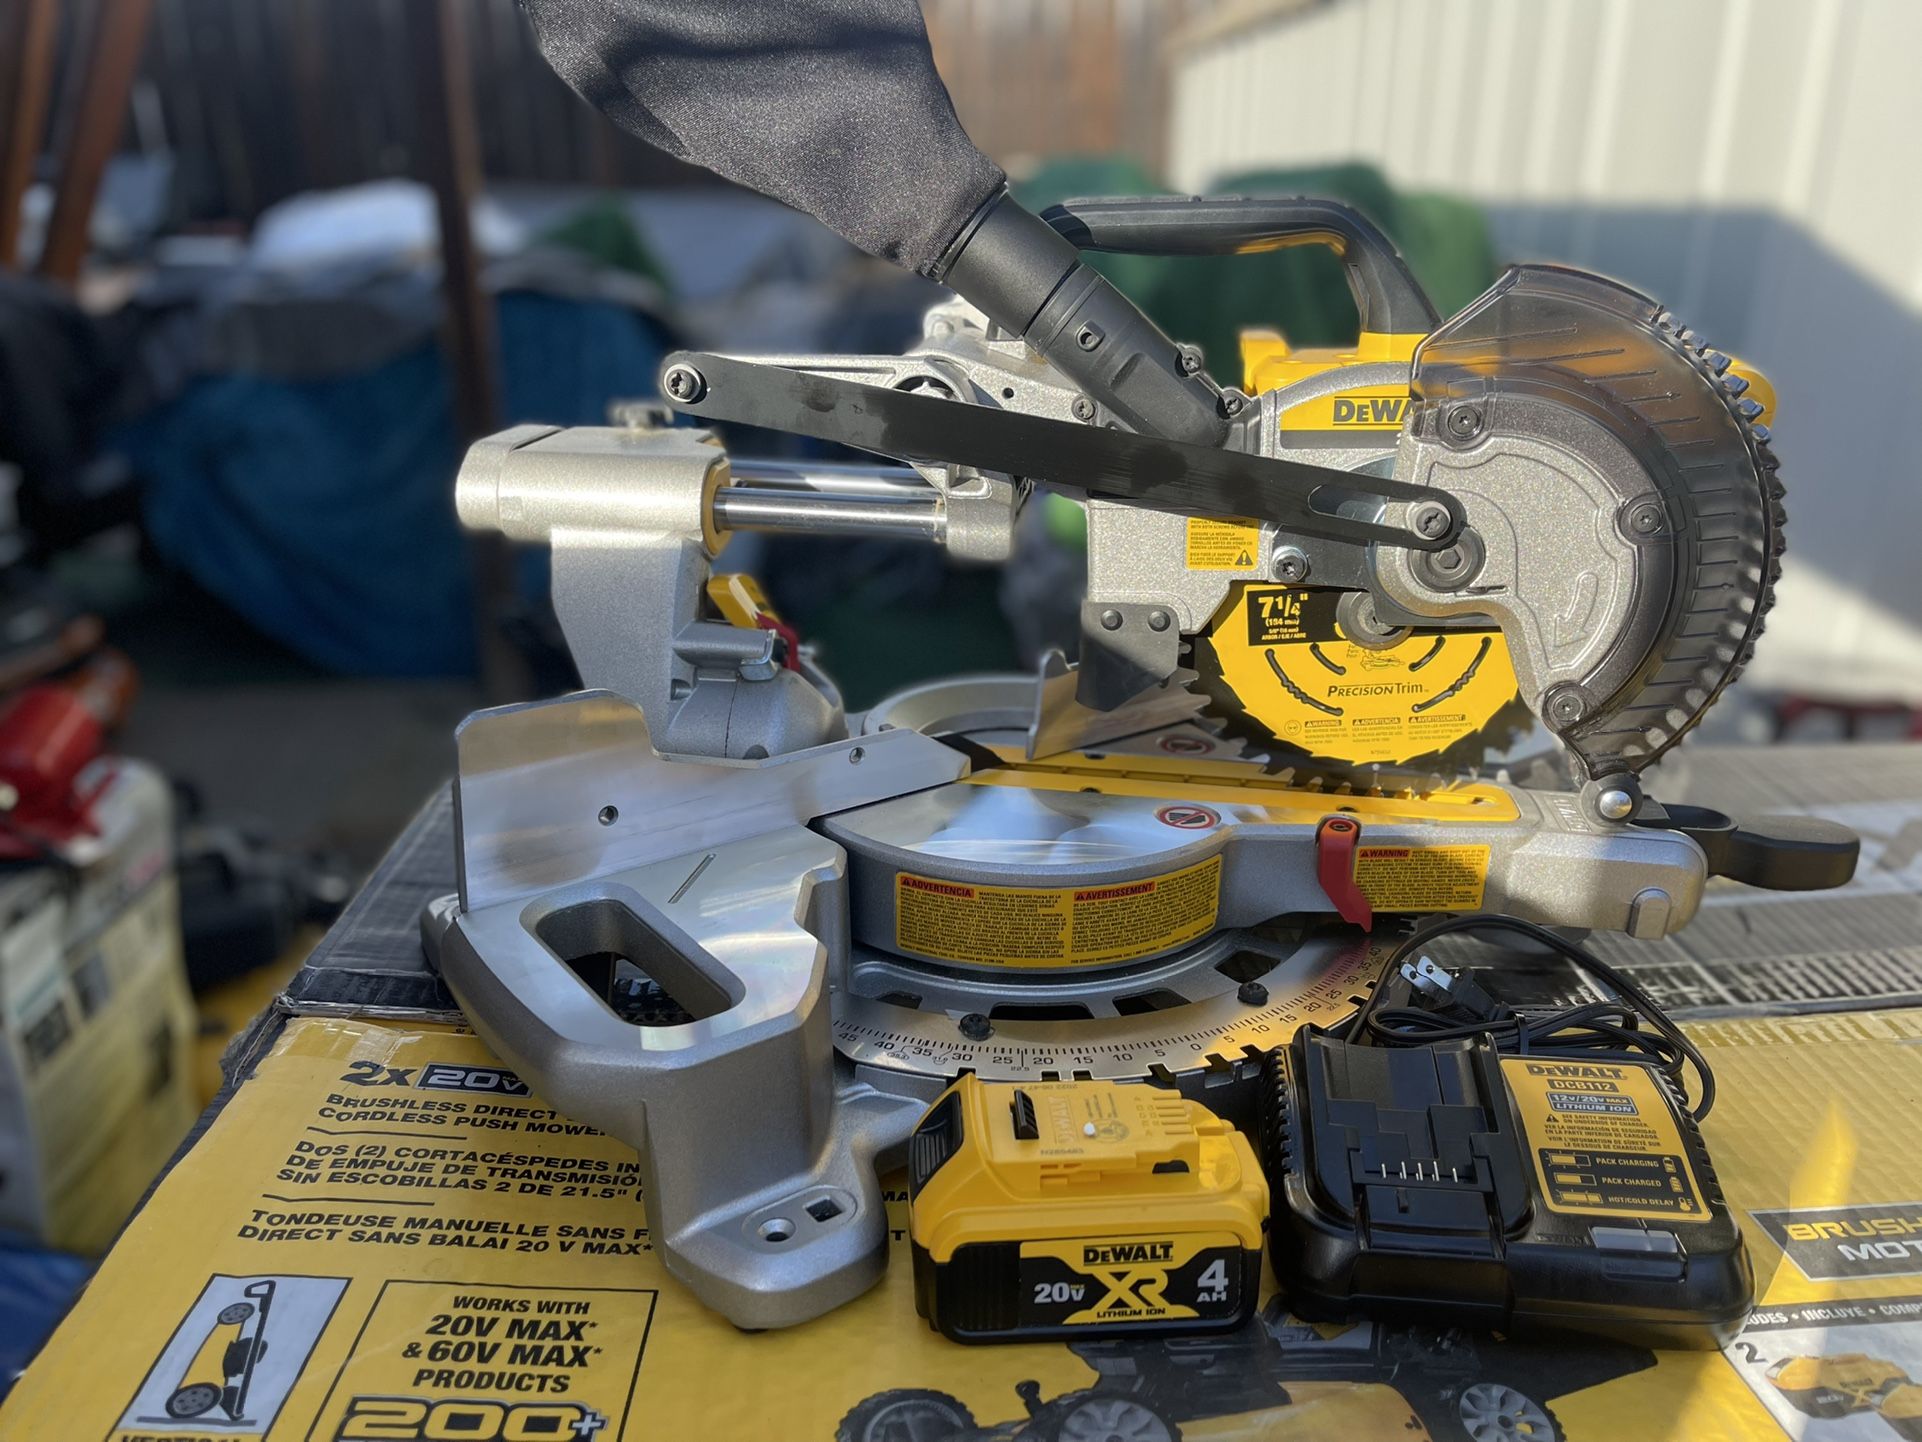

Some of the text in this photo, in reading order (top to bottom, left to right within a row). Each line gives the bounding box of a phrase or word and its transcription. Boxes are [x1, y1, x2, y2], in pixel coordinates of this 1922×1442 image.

[1369, 849, 1409, 857] WARNING
[912, 879, 972, 898] ADVERTENCIA
[1087, 882, 1153, 901] AVERTISSEMENT
[838, 1032, 857, 1042] 45
[874, 1040, 895, 1050] 40
[912, 1046, 933, 1057] 35
[951, 1052, 973, 1062] 30
[992, 1056, 1013, 1065] 25
[1032, 1056, 1054, 1065] 20
[1073, 1055, 1094, 1065] 15
[1112, 1052, 1133, 1062] 10
[1155, 1049, 1166, 1058] 5
[1190, 1043, 1202, 1052] 0
[1223, 1035, 1236, 1044] 5
[1251, 1024, 1271, 1035] 10
[1279, 1013, 1298, 1024] 15
[1303, 1001, 1322, 1013] 20
[1325, 988, 1343, 1000] 25
[1343, 975, 1360, 986] 30
[1357, 959, 1372, 971] 35
[1368, 945, 1382, 957] 40
[426, 1068, 524, 1090] 20V
[1526, 1064, 1623, 1079] DEWALT
[1553, 1080, 1614, 1091] DCB112
[326, 1093, 557, 1120] BRUSHLESS DIRECT
[1556, 1103, 1606, 1111] LITHIUM
[318, 1107, 606, 1136] CORDLESS PUSH MOWE
[285, 1154, 322, 1170] DE
[327, 1157, 436, 1173] EMPUJE
[441, 1162, 478, 1176] DE
[295, 1141, 348, 1157] DOS
[354, 1144, 388, 1160] (2)
[394, 1145, 609, 1172] CORTACÉSPEDES
[1595, 1157, 1660, 1168] PACK CHARGING
[276, 1168, 321, 1184] SIN
[326, 1170, 488, 1191] ESCOBILLAS
[495, 1180, 512, 1192] 2
[518, 1183, 552, 1196] DE
[560, 1185, 628, 1199] 21.5"
[1602, 1176, 1662, 1188] PACK CHARGED
[1608, 1196, 1675, 1207] HOT/COLD DELAY
[251, 1209, 395, 1229] TONDEUSE
[402, 1217, 549, 1238] MANUELLE
[555, 1225, 625, 1240] SANS
[237, 1224, 342, 1242] DIRECT
[347, 1230, 420, 1246] SANS
[427, 1233, 508, 1250] BALAI
[515, 1239, 551, 1252] 20
[557, 1240, 577, 1254] V
[1084, 1243, 1173, 1265] DEWALT
[1197, 1259, 1229, 1293] 4
[1034, 1282, 1084, 1304] 20V
[1092, 1269, 1171, 1309] XR
[1197, 1291, 1227, 1303] AH
[452, 1295, 591, 1315] WORKS WITH
[1097, 1307, 1166, 1319] LITHIUM ION
[1747, 1302, 1922, 1325] UDES INCLUYE COMP
[425, 1314, 500, 1337] 20V
[402, 1342, 422, 1359] &
[427, 1340, 501, 1365] 60V
[1735, 1342, 1768, 1364] 2
[412, 1368, 571, 1393] PRODUCTS
